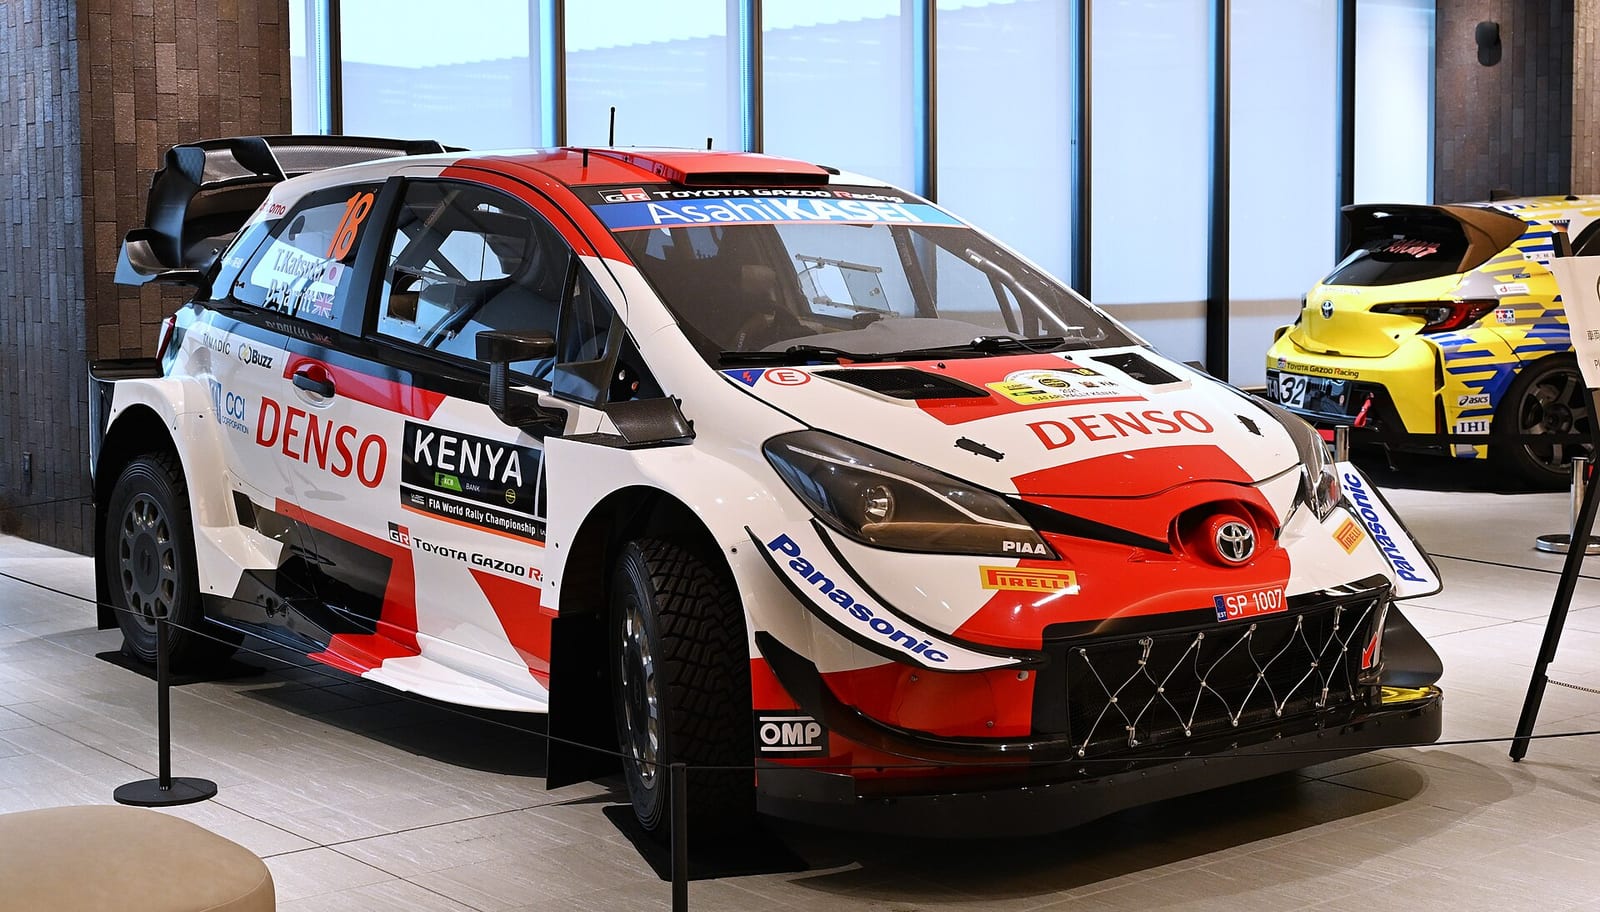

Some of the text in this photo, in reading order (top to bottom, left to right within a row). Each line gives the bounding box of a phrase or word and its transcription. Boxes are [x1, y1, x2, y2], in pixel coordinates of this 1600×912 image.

[605, 188, 905, 204] GR TOYOTA GAZOO Racing
[326, 191, 376, 262] 18
[1287, 362, 1360, 379] TOYOTA GAZOO Racing
[225, 391, 246, 421] CCI
[1280, 377, 1306, 405] 32
[1026, 409, 1213, 451] DENSO
[1460, 421, 1486, 433] IHI
[255, 395, 388, 490] DENSO
[414, 429, 523, 488] KENYA
[465, 483, 481, 493] BANK
[429, 498, 441, 511] FIA
[442, 502, 464, 516] World
[465, 508, 484, 523] Rally
[485, 512, 536, 536] Championship
[1343, 472, 1428, 584] Panasonic
[1002, 540, 1047, 556] PIAA
[1336, 520, 1363, 551] PIRELLI
[388, 529, 411, 546] GR
[413, 537, 468, 562] TOYOTA
[471, 553, 526, 577] GAZOO
[987, 569, 1070, 590] PIRELLI
[767, 533, 950, 663] Panasonic
[1226, 588, 1282, 616] SP 1007
[759, 721, 822, 745] OMP
